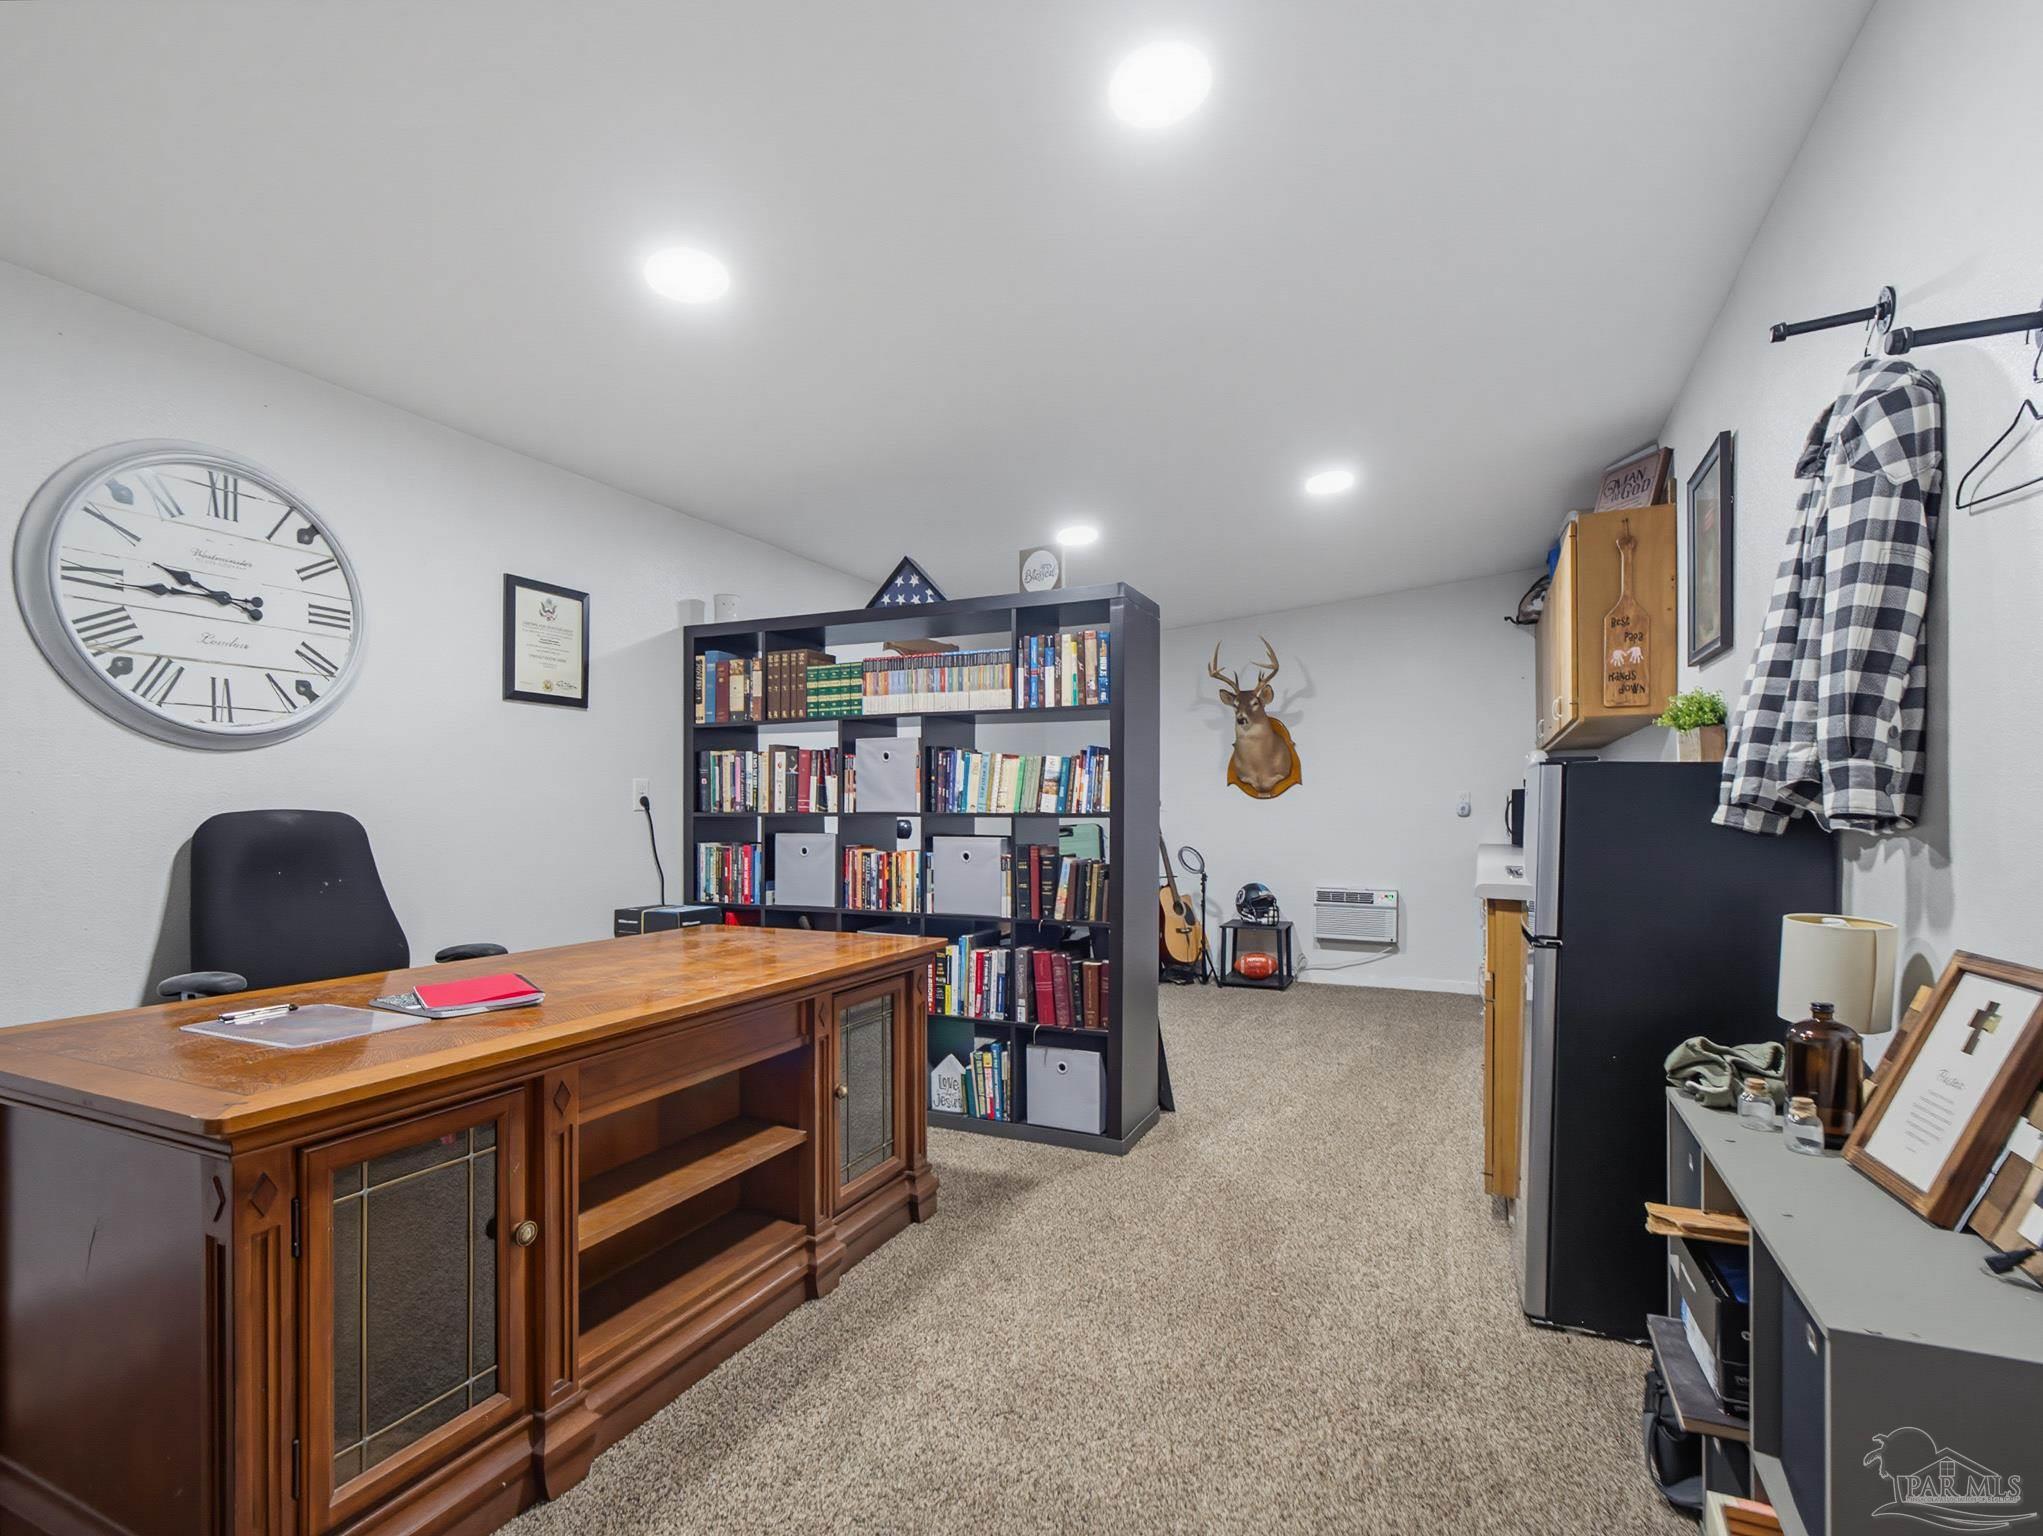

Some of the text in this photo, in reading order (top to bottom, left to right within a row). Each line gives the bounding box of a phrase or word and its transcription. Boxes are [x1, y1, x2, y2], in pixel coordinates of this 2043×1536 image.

[206, 471, 238, 522] XII
[1610, 616, 1630, 628] Best
[197, 632, 251, 650] London
[938, 1074, 960, 1091] Love
